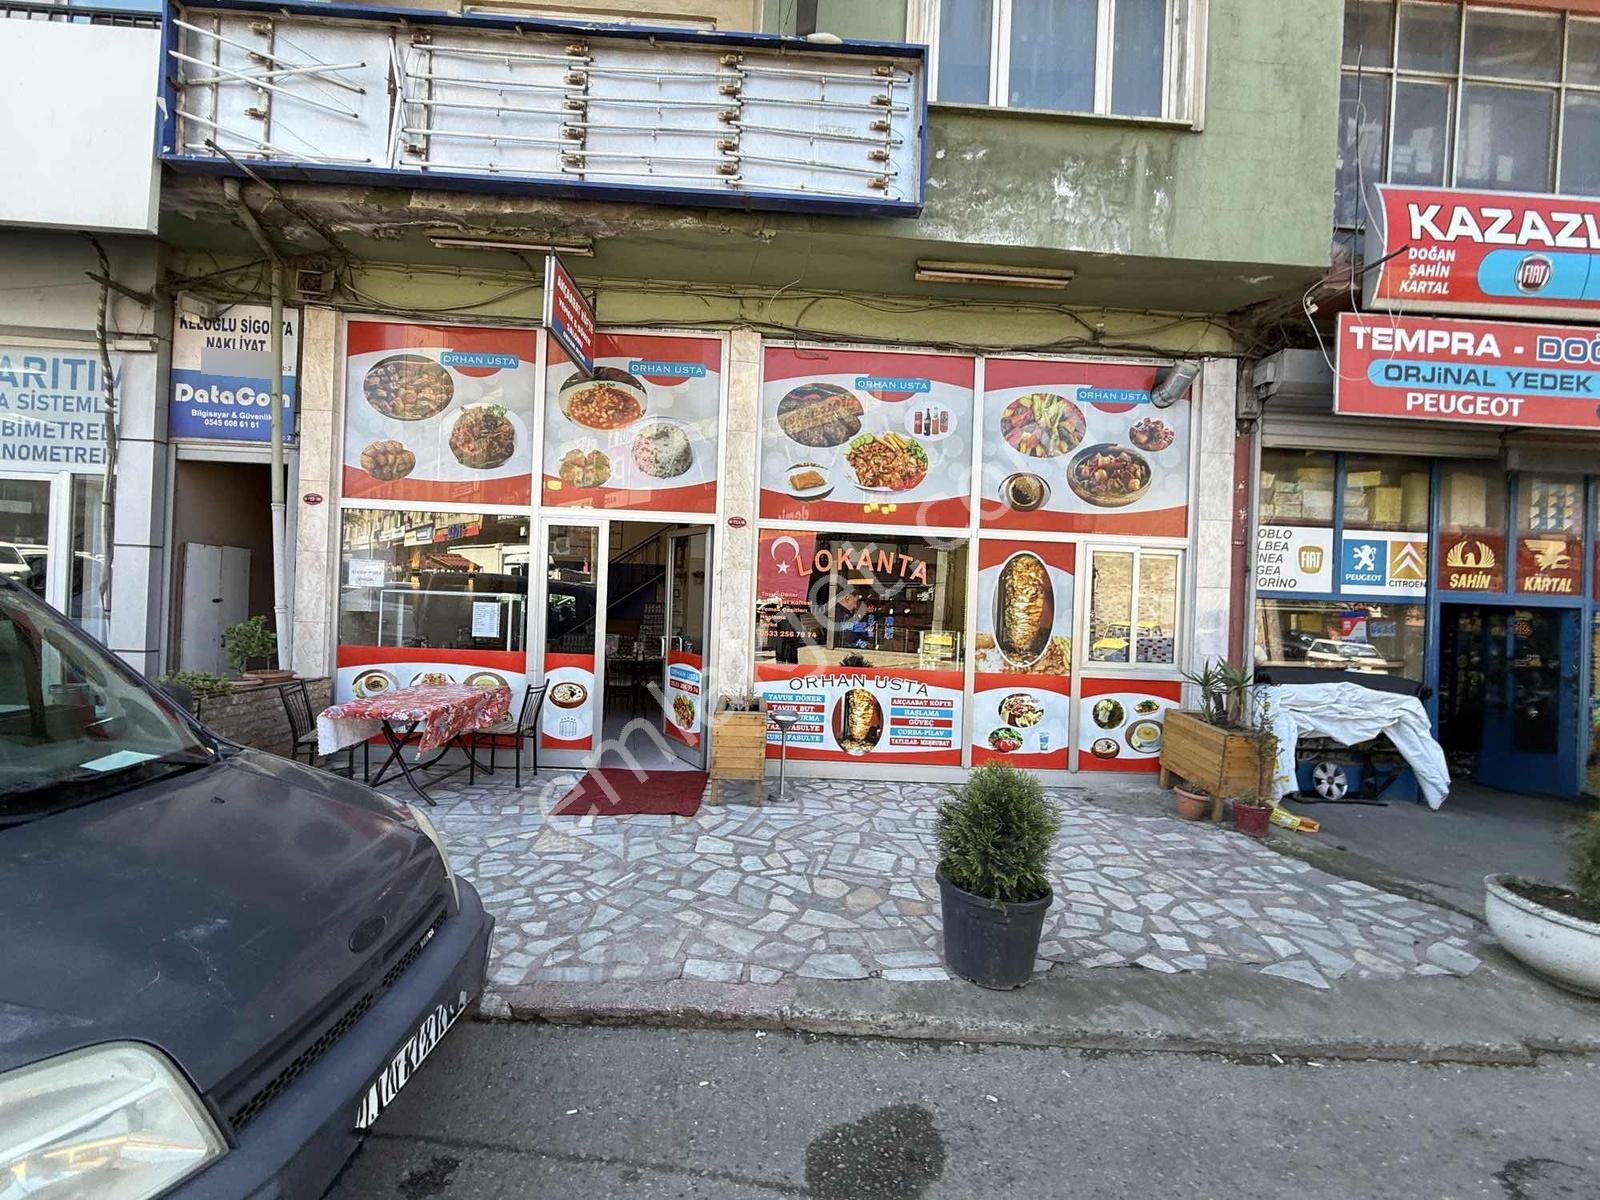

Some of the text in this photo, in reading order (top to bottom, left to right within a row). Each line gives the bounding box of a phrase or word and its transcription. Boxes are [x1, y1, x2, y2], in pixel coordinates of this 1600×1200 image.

[1408, 245, 1456, 262] DOĞAN
[1408, 263, 1450, 280] ŞAHİN
[1523, 263, 1547, 284] FIAT
[1399, 279, 1450, 295] KARTAL
[1349, 326, 1502, 358] TEMPRA
[443, 355, 516, 366] ORHAN USTA
[631, 364, 703, 375] ORHAN USTA
[857, 380, 928, 390] ORHAN USTA
[1506, 371, 1593, 392] YEDEK
[1079, 391, 1148, 401] ORHAN USTA
[1406, 392, 1525, 417] PEUGEOT
[191, 409, 229, 419] Bilgisayar
[231, 411, 238, 419] &
[204, 419, 223, 427] 0545
[797, 547, 928, 585] LOKANTA
[1300, 551, 1322, 568] FIAT
[1344, 573, 1383, 582] PEUGEOT
[1449, 571, 1492, 590] ŞAHİN
[1523, 576, 1573, 592] KARTAL
[789, 674, 929, 697] ORHAN USTA
[768, 693, 823, 702] TAVUK DÖNER
[892, 698, 928, 707] AKÇAABAT
[908, 718, 935, 727] GÜVEÇ
